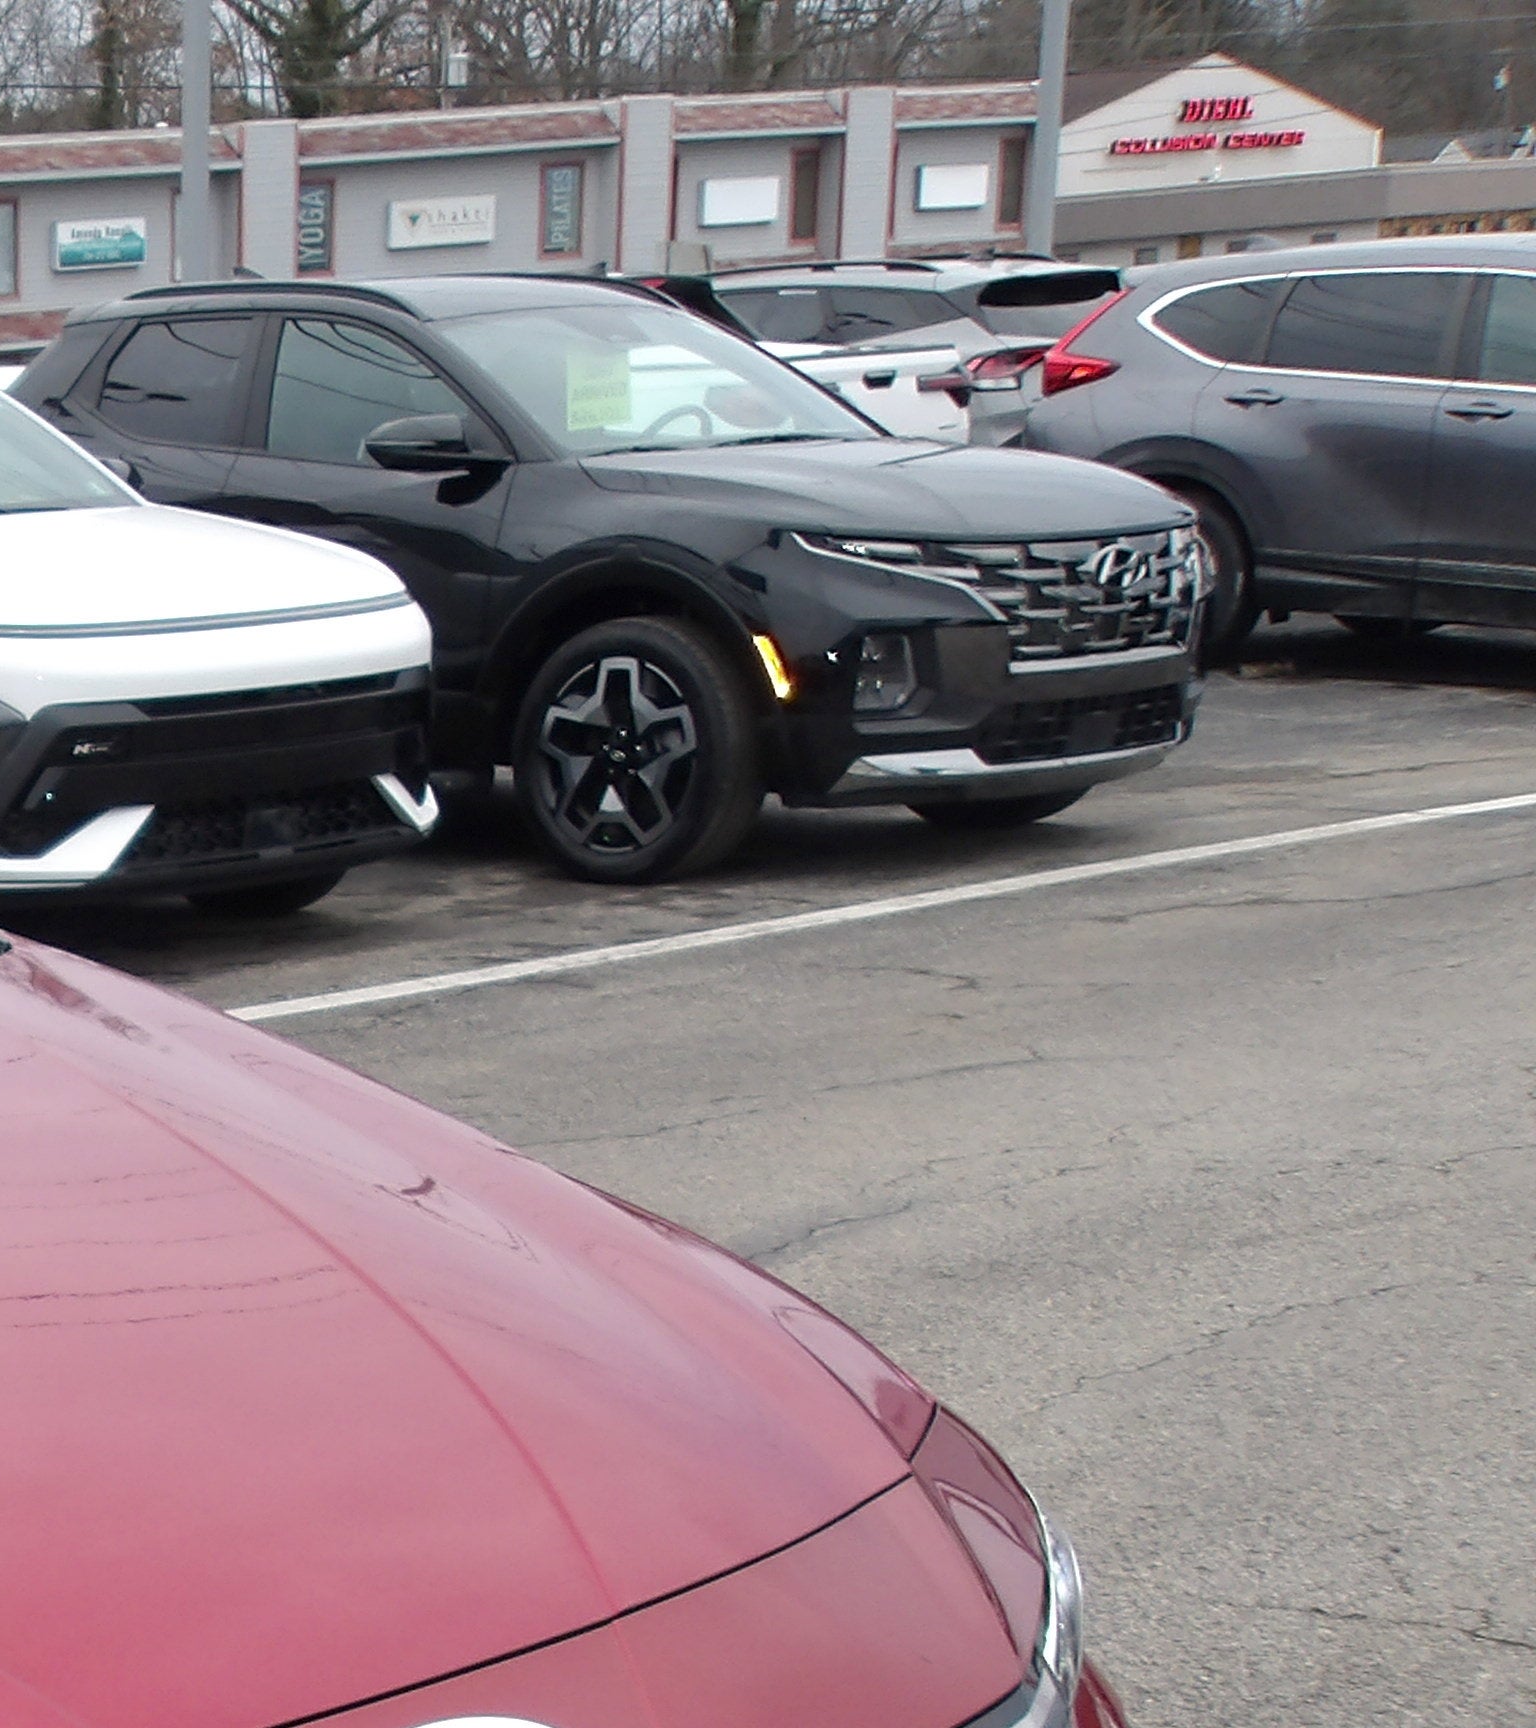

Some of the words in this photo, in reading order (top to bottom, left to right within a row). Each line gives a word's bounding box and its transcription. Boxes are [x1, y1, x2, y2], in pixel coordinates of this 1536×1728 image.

[1113, 132, 1218, 155] COLLISION
[1228, 128, 1306, 149] CENTER
[298, 188, 326, 261] YOGA
